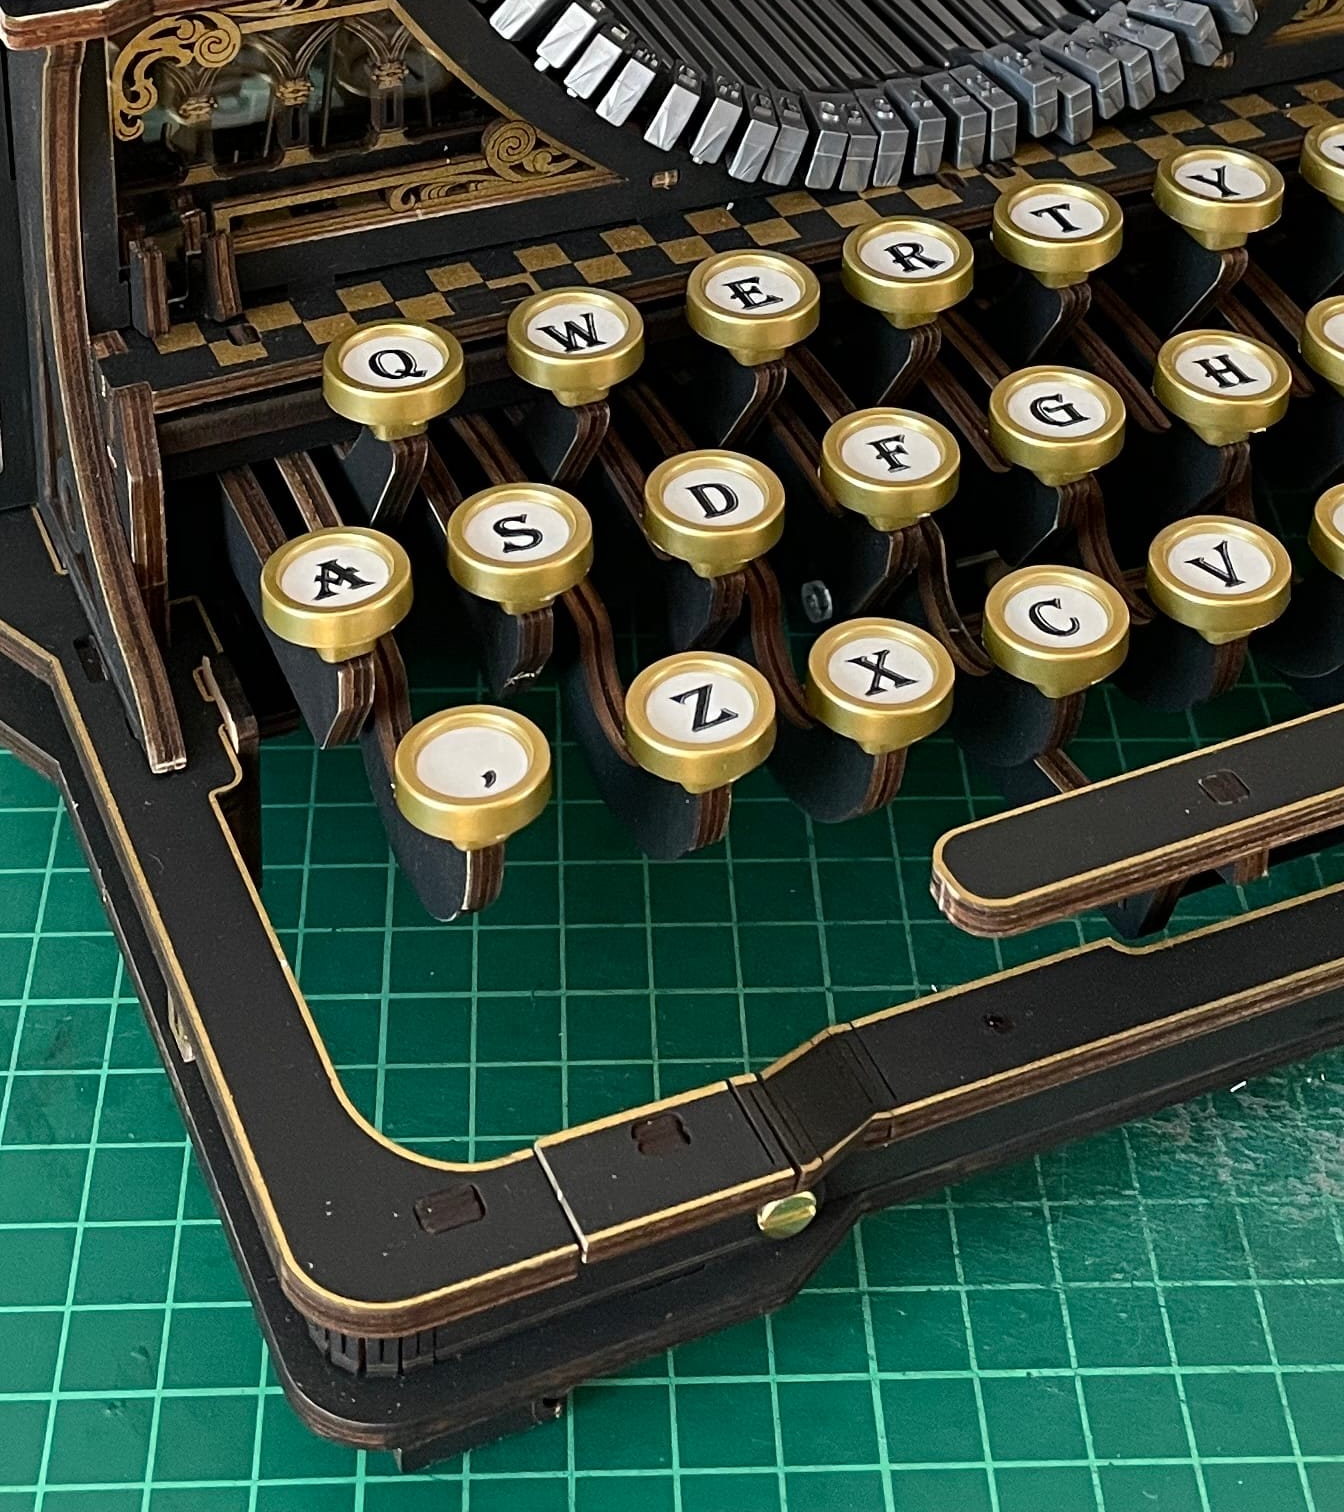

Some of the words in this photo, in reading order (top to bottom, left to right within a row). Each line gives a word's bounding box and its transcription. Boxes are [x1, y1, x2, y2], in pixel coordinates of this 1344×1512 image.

[368, 349, 428, 380] Q
[535, 312, 607, 354] W
[722, 276, 784, 311] E
[883, 242, 945, 273] R
[1029, 203, 1081, 233] T
[1186, 165, 1241, 198] Y
[313, 558, 375, 601] A
[492, 513, 543, 554] S
[685, 483, 739, 519] D
[867, 434, 911, 473] F
[1029, 393, 1091, 428] G
[1192, 354, 1258, 389] H
[669, 684, 739, 733] Z
[846, 649, 918, 697] X
[1028, 598, 1081, 637] C
[1184, 540, 1246, 588] V
